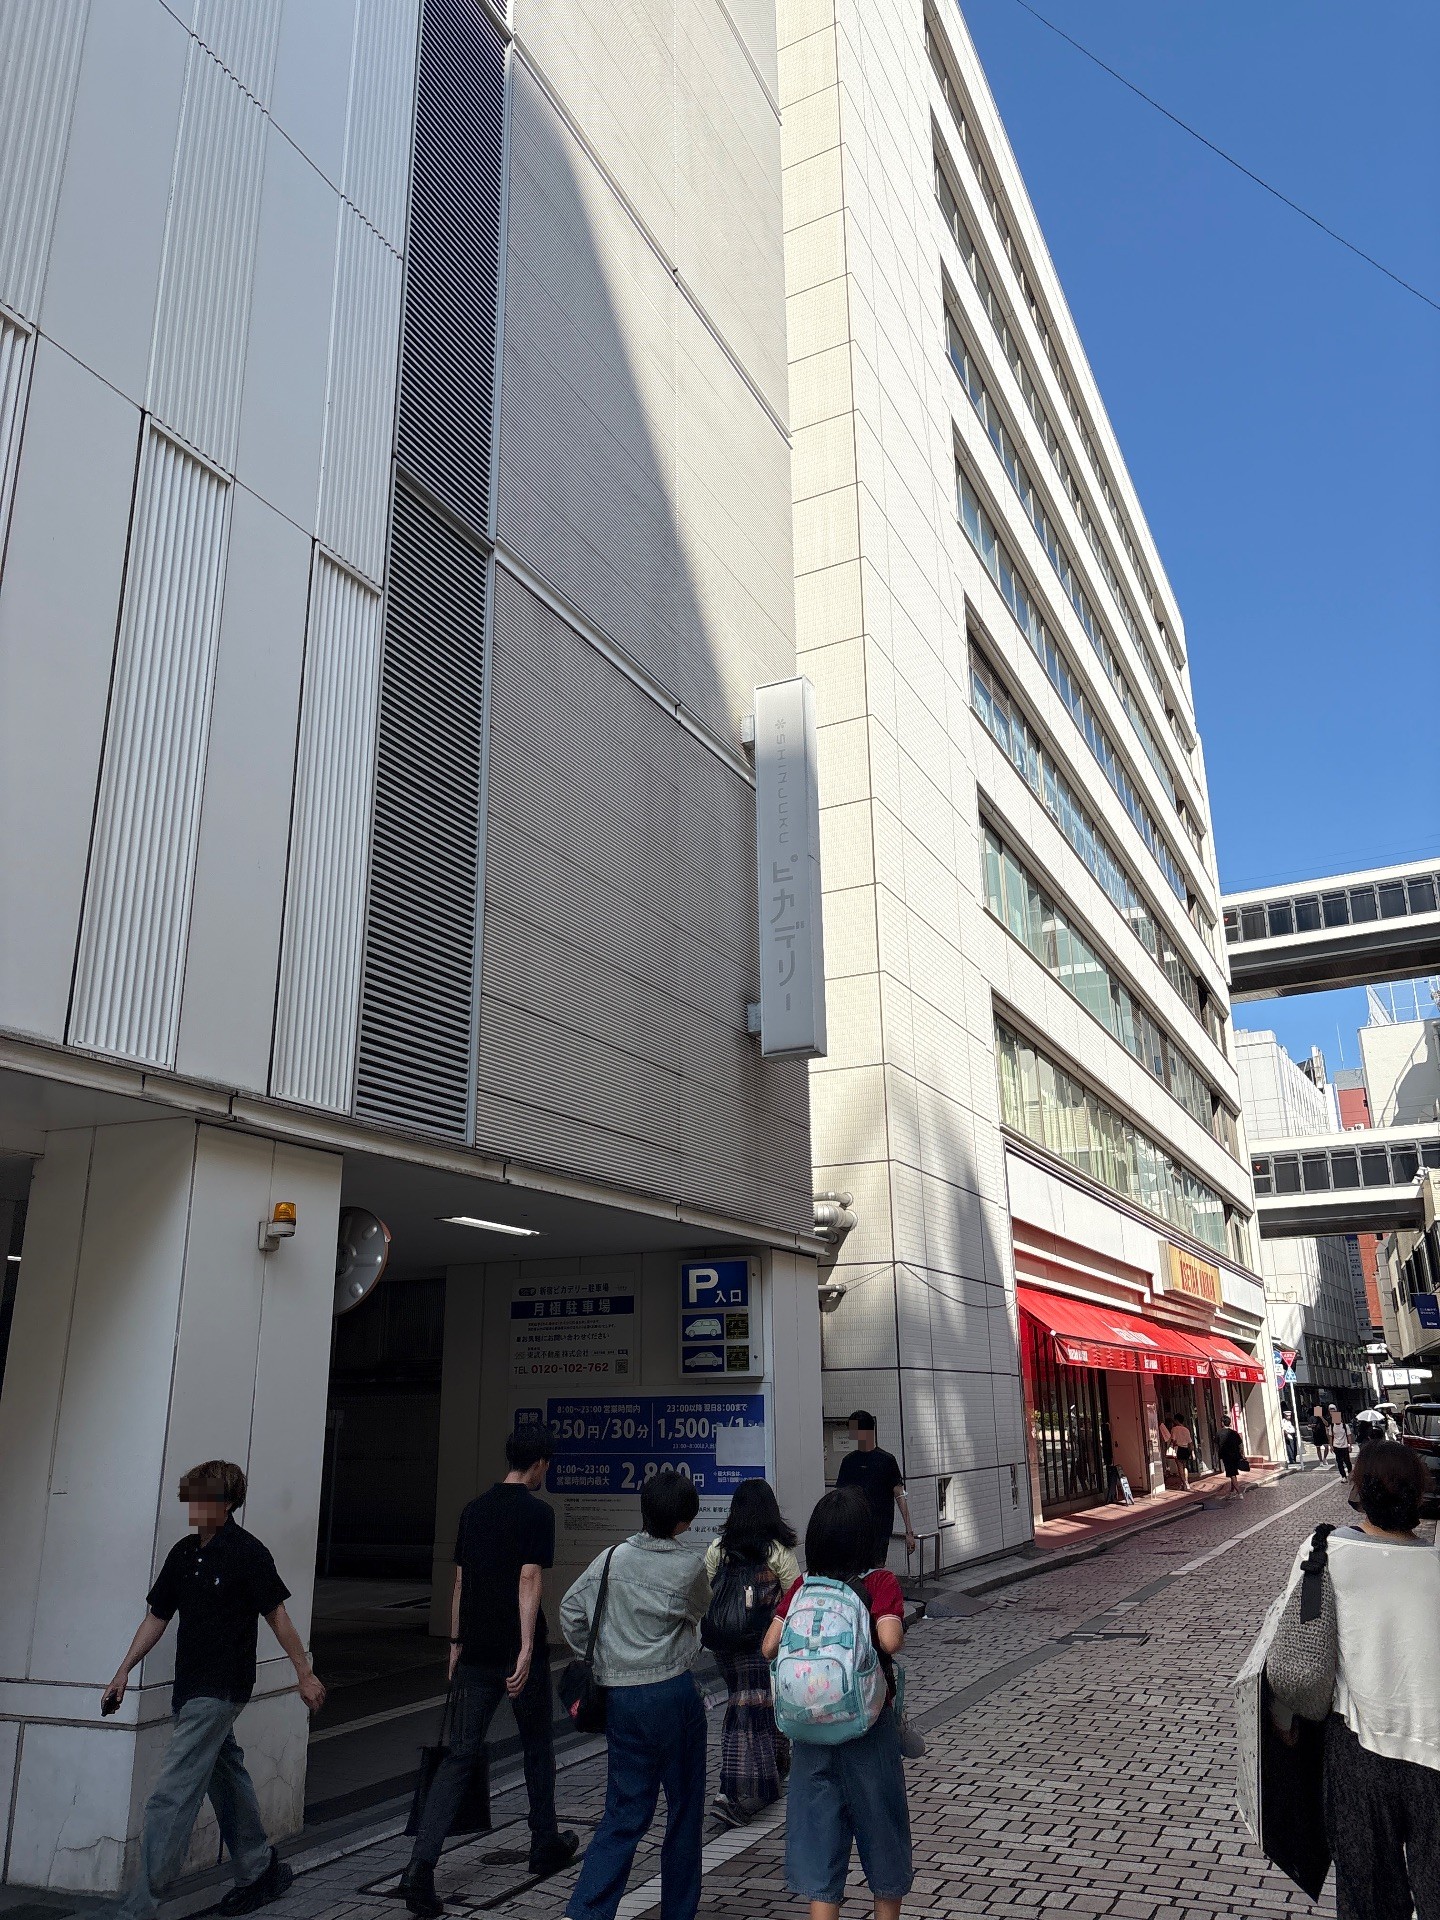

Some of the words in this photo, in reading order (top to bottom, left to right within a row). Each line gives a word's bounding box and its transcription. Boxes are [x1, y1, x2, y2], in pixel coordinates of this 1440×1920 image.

[774, 734, 789, 845] SHINJUKU
[770, 854, 806, 1011] ピカデリー
[539, 1283, 610, 1296] 新宿ピカデリー駐車場
[688, 1268, 719, 1304] P
[715, 1289, 743, 1304] 入口
[533, 1298, 612, 1317] 月極駐車場
[514, 1366, 528, 1375] TEL
[531, 1363, 609, 1375] 0120-102-762
[603, 1404, 641, 1415] 営業時間内
[666, 1404, 702, 1413] 23:00以降
[556, 1476, 611, 1487] 営業時間内最大
